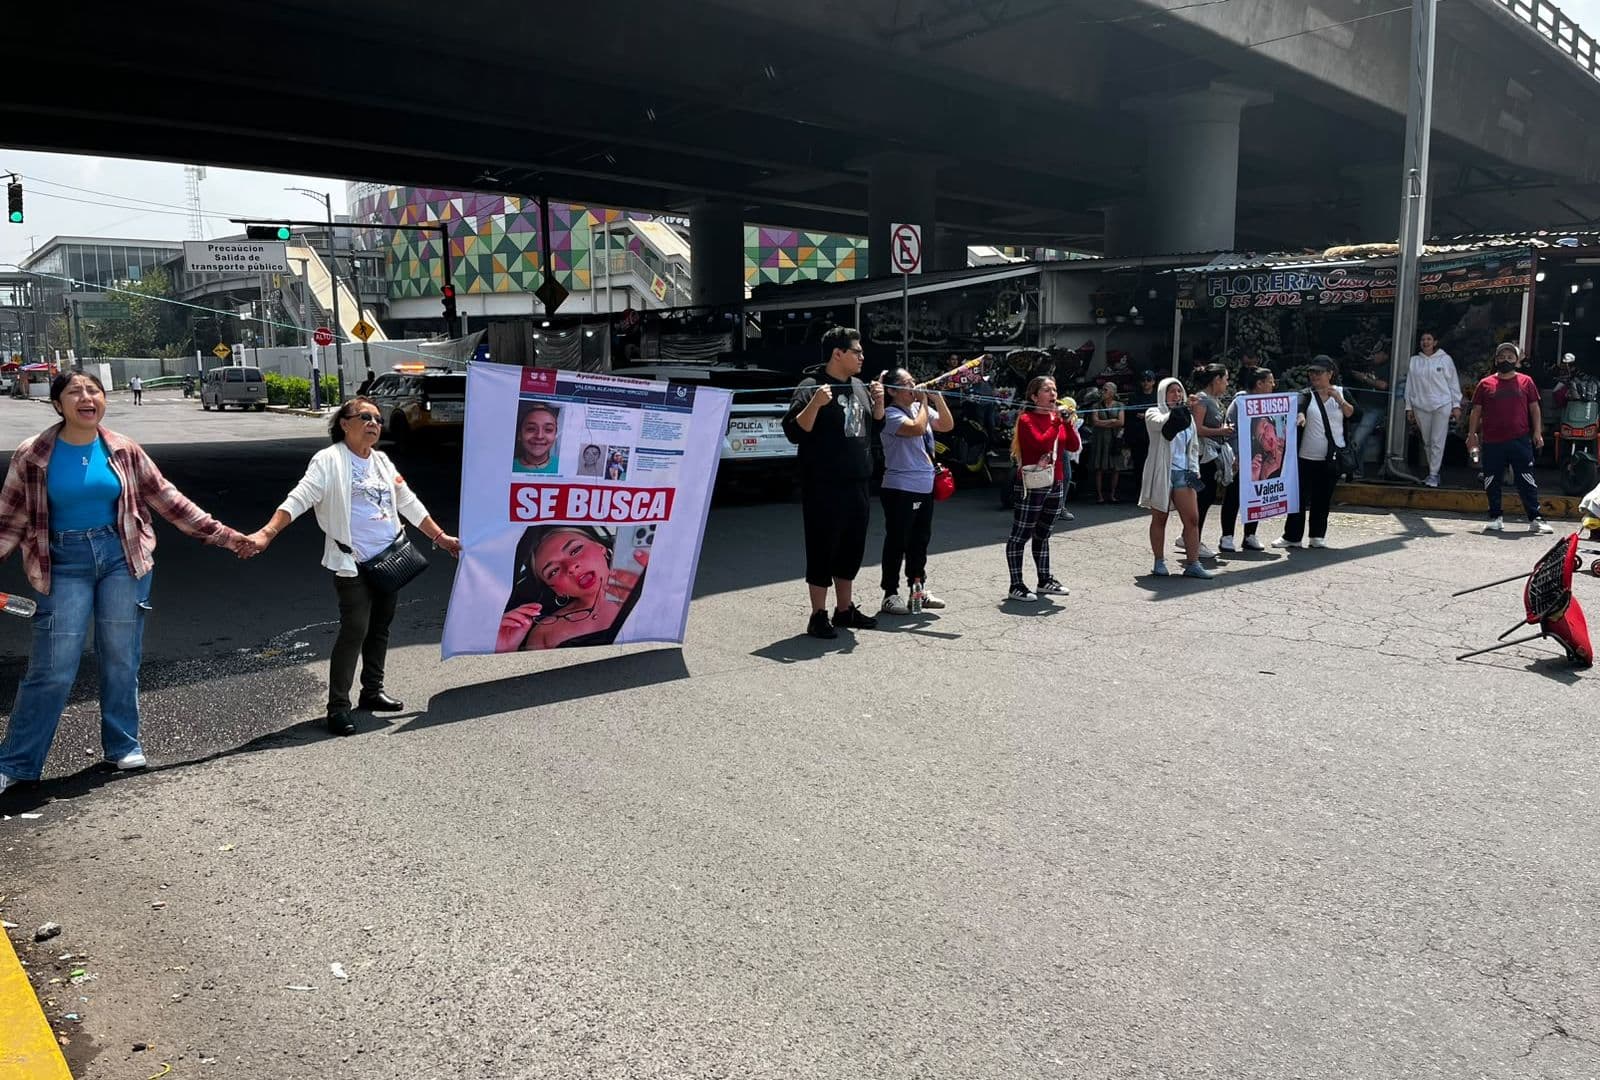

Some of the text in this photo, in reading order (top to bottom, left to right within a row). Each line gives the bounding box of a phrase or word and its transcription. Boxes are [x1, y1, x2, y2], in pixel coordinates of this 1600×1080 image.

[191, 263, 283, 272] transporte público
[1229, 294, 1251, 309] 55
[1254, 291, 1303, 308] 2702
[1319, 289, 1369, 305] 9799
[1247, 397, 1289, 415] SE BUSCA
[1254, 481, 1285, 497] Valeria
[515, 487, 667, 520] SE BUSCA
